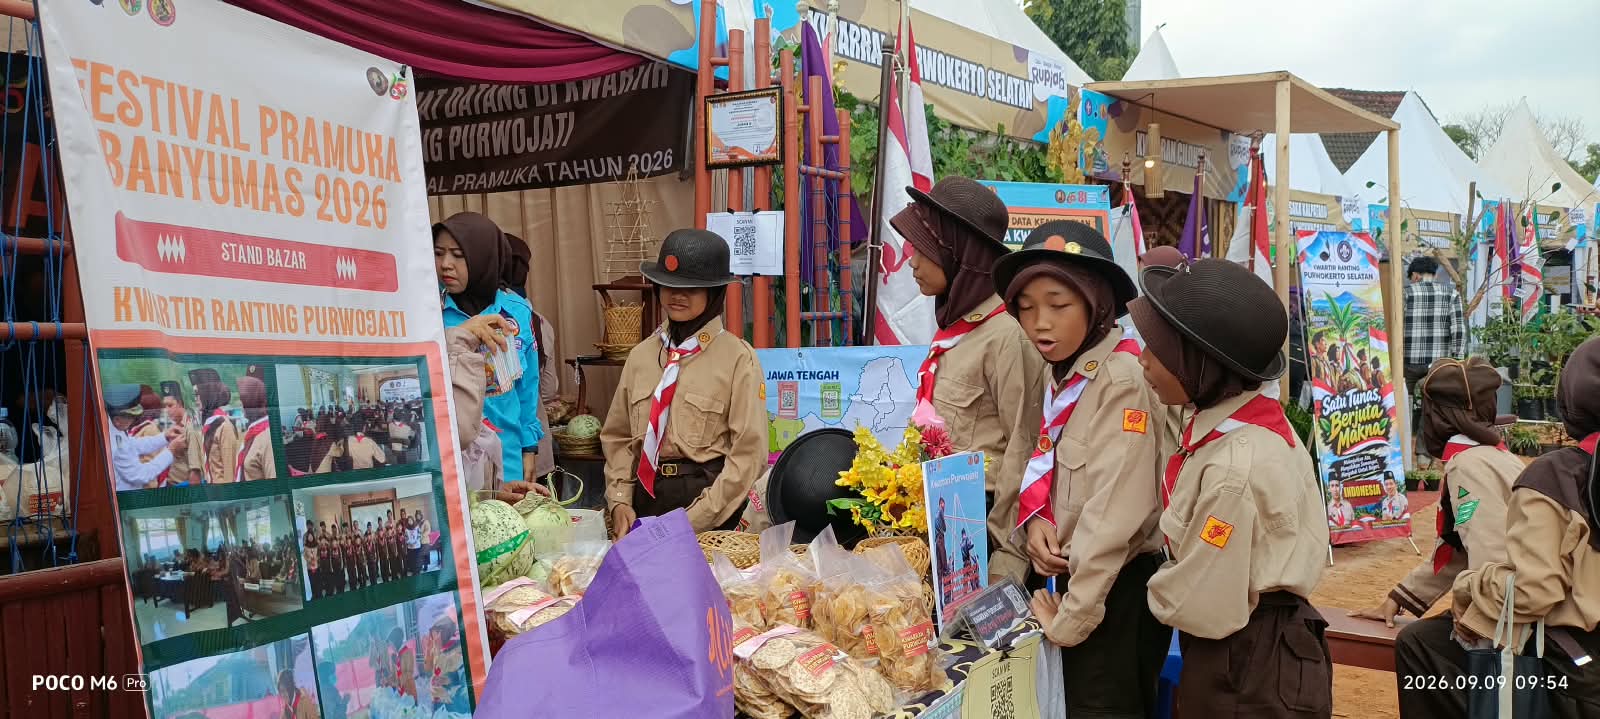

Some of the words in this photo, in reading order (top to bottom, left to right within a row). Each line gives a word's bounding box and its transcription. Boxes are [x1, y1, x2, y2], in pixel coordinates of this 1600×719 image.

[807, 9, 886, 67] KWARRA
[987, 68, 1033, 110] SELATAN
[1031, 66, 1065, 90] Rupiah
[444, 83, 528, 118] DATANG
[259, 104, 402, 183] PRAMUKA
[448, 111, 575, 160] PURWOJATI
[98, 129, 305, 217] BANYUMAS
[314, 173, 388, 230] 2026
[452, 164, 542, 192] PRAMUKA
[543, 155, 623, 182] TAHUN
[628, 148, 673, 175] 2026
[1012, 217, 1032, 226] DATA
[221, 242, 263, 266] STAND
[267, 249, 307, 270] BAZAR
[1304, 271, 1346, 280] PURWOKERTO
[211, 297, 299, 334] RANTING
[303, 305, 407, 337] PURWOJATI
[766, 370, 794, 380] JAWA
[797, 370, 840, 380] TENGAH
[1322, 393, 1348, 416] Satu
[1348, 387, 1382, 408] Tunas,
[1328, 403, 1384, 440] Berjuta
[1337, 421, 1385, 455] Makna
[1343, 483, 1382, 498] INDONESIA
